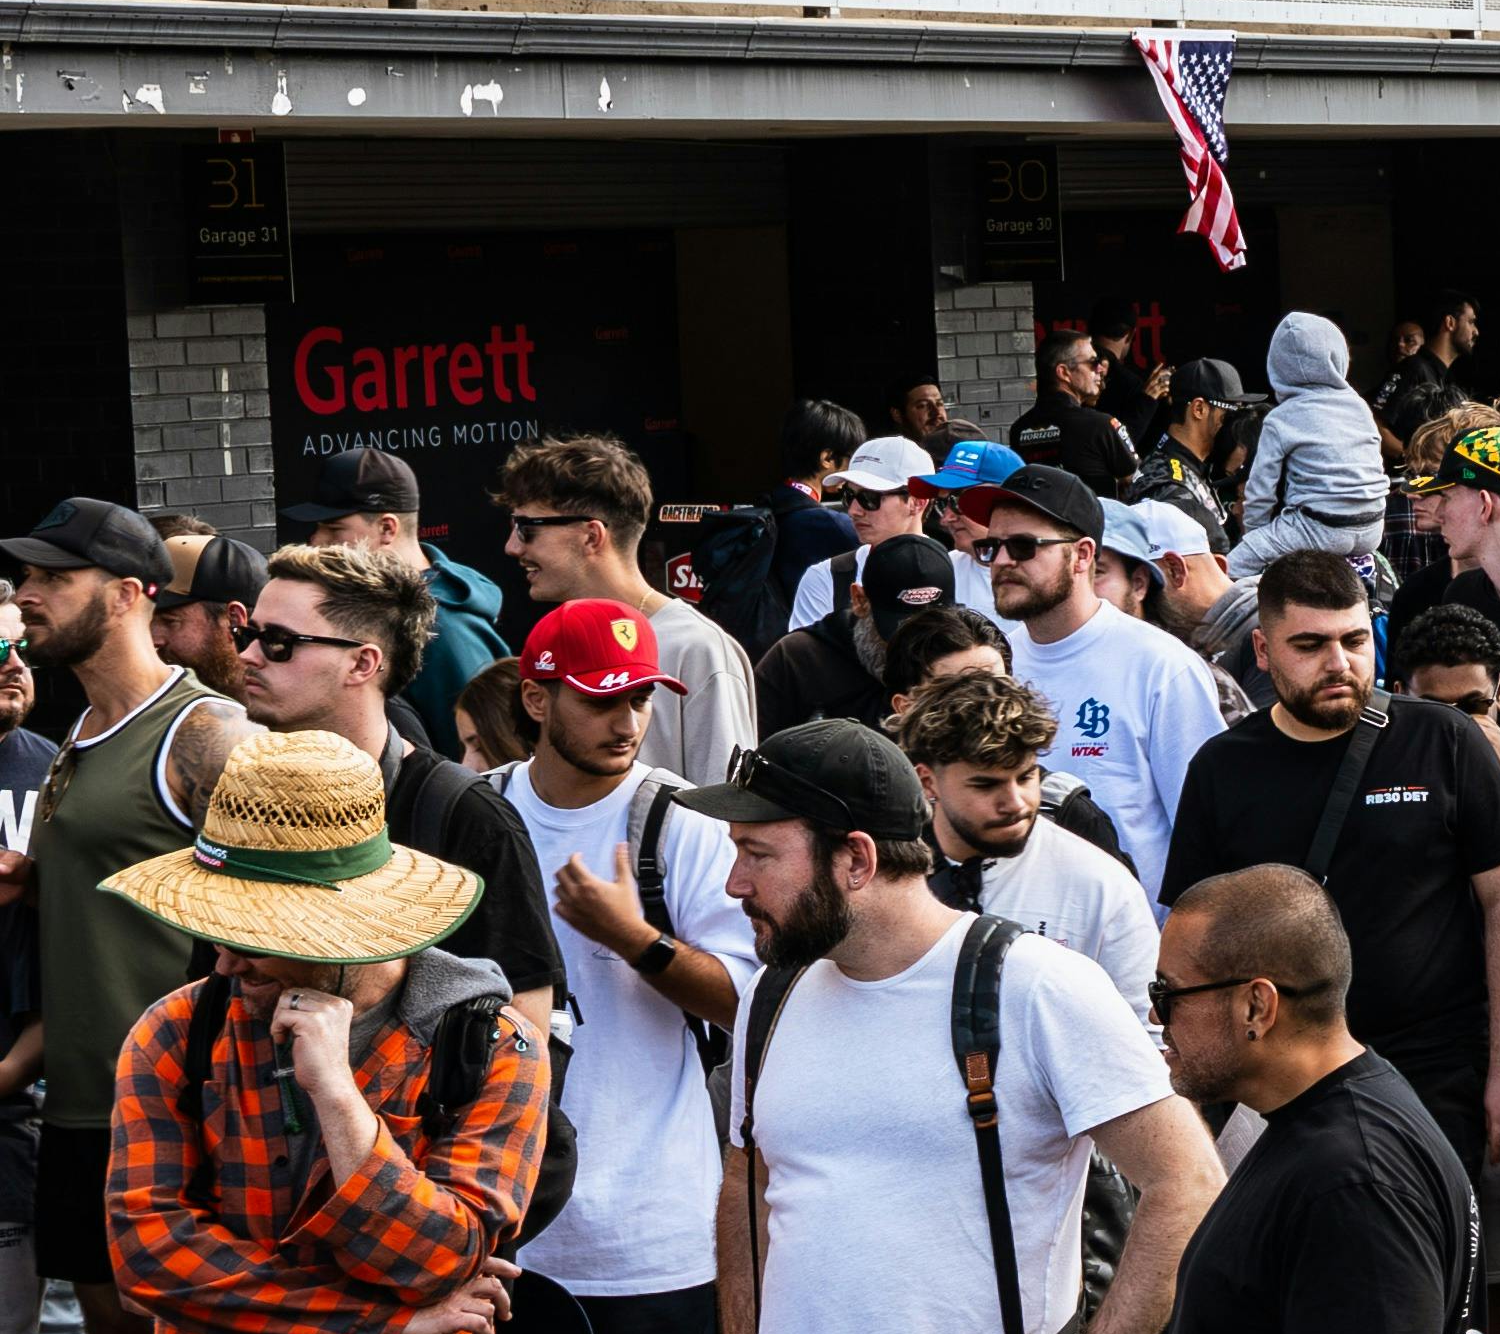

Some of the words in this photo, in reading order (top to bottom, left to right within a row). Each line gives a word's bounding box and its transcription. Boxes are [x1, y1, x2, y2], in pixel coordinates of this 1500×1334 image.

[207, 157, 267, 210] 31
[987, 159, 1048, 204] 30
[199, 226, 254, 246] Garage
[258, 225, 280, 242] 31
[986, 216, 1032, 234] Garage
[1035, 216, 1053, 232] 30
[294, 323, 538, 416] Garrett
[303, 422, 441, 457] ADVANCING
[452, 419, 541, 450] MOTION
[599, 671, 631, 688] 44
[1071, 746, 1105, 758] WTAC
[1403, 791, 1429, 803] DET
